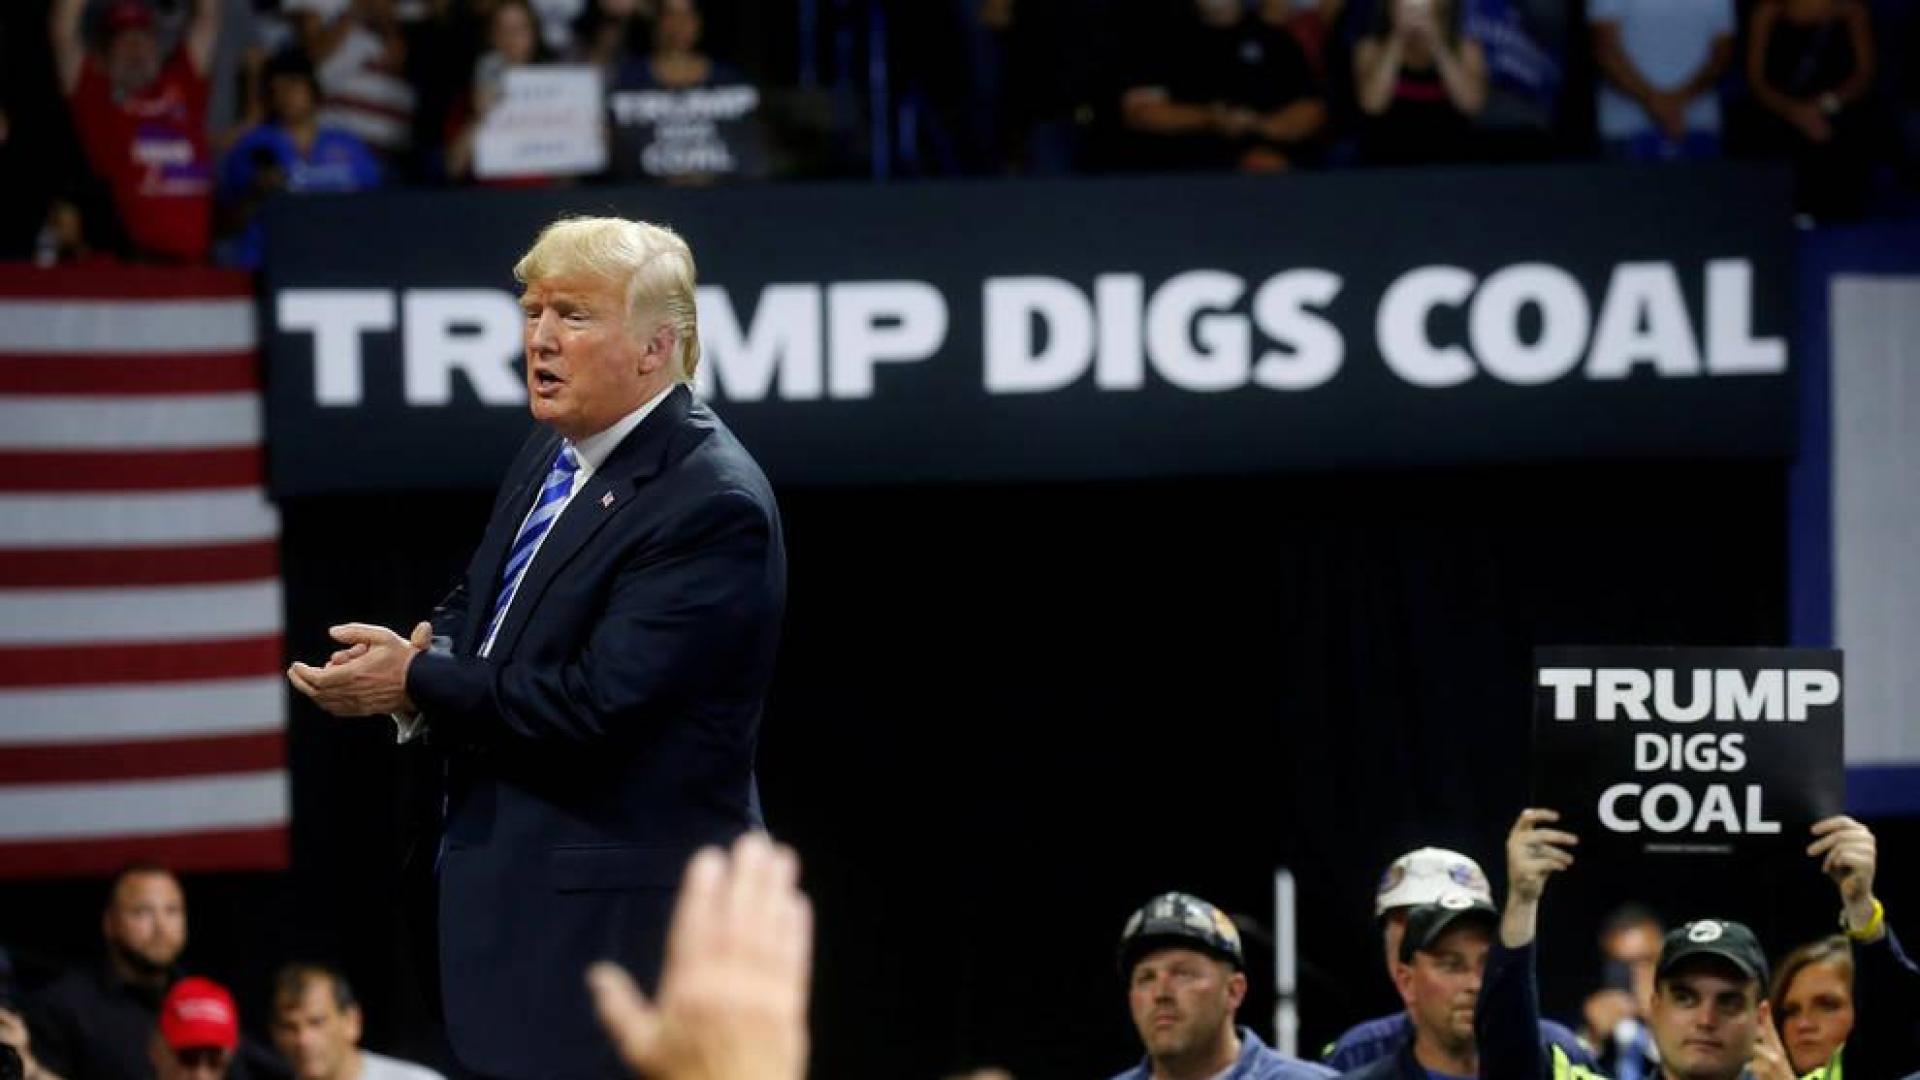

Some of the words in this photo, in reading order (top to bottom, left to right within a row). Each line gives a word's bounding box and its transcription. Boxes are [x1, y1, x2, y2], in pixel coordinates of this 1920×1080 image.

[277, 281, 949, 408] TRMP
[983, 268, 1344, 393] DIGS
[1375, 259, 1787, 387] COAL
[1538, 668, 1841, 723] TRUMP
[1634, 732, 1747, 772] DIGS
[1598, 782, 1782, 833] COAL
